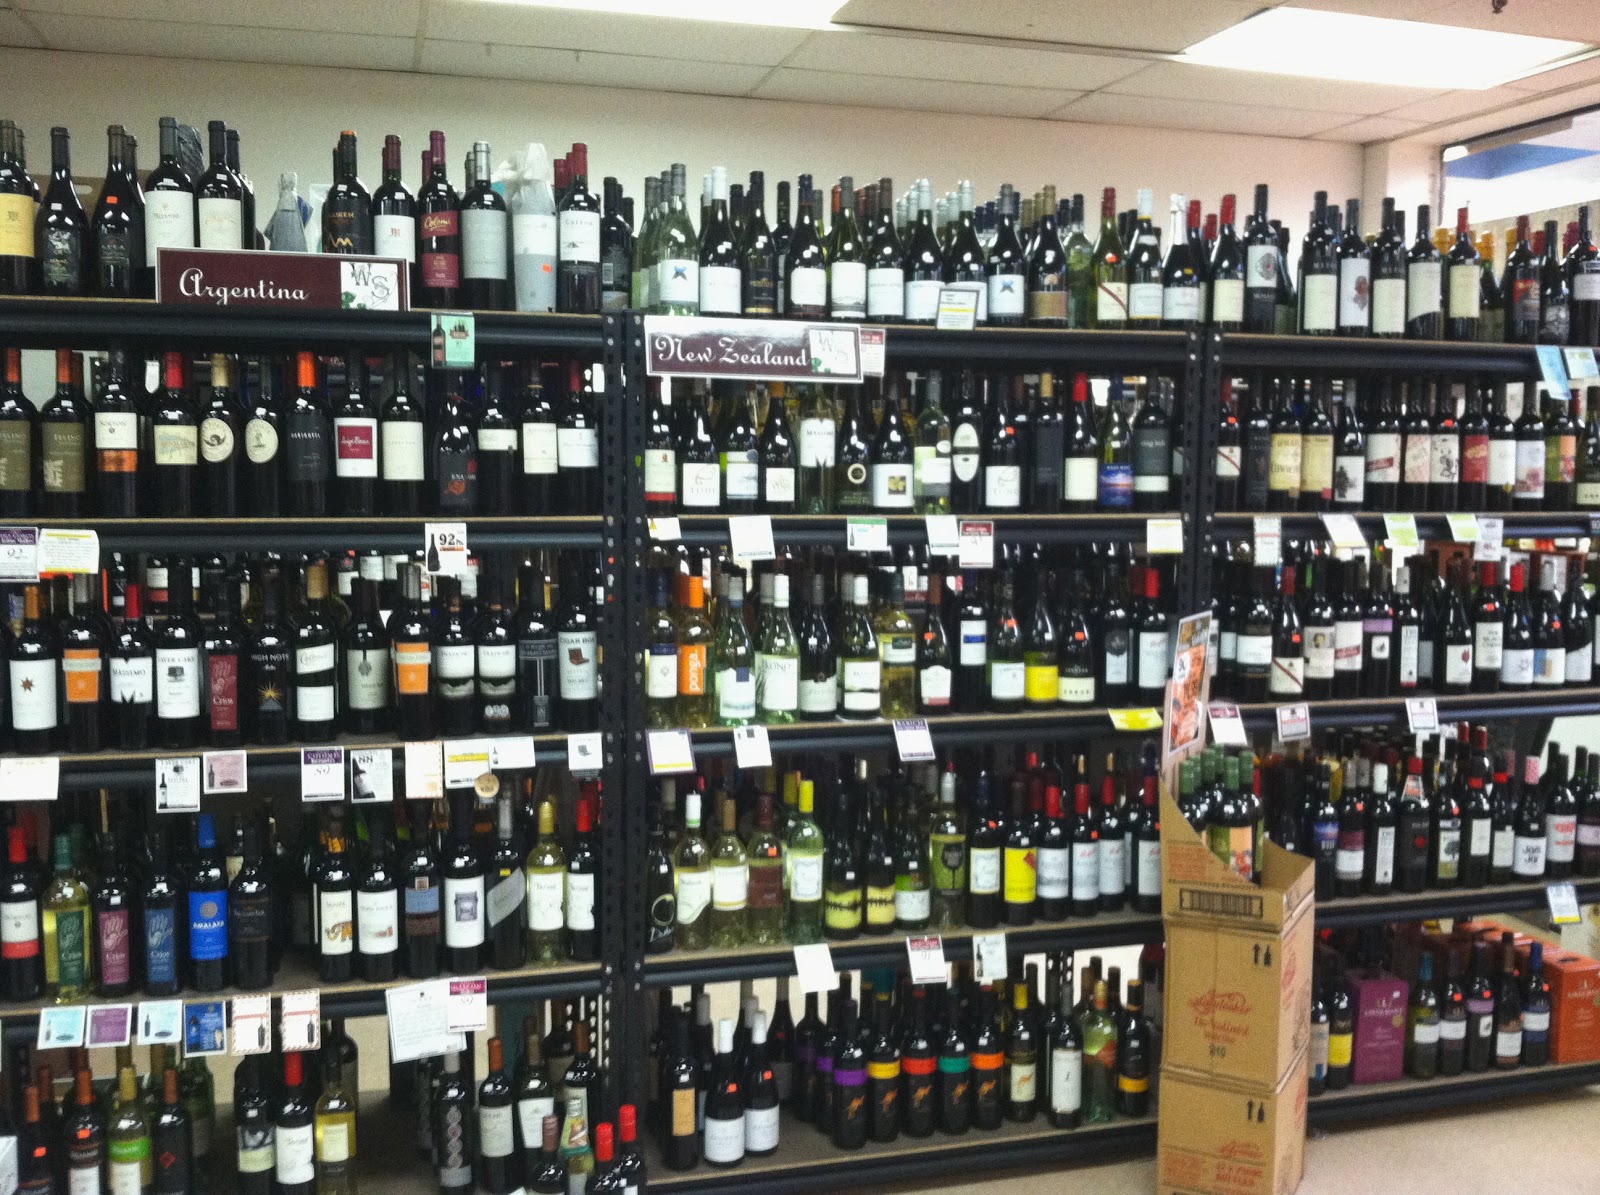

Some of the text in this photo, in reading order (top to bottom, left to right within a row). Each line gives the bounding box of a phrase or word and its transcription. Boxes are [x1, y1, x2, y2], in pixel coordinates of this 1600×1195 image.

[179, 266, 310, 305] Argentina
[655, 335, 810, 367] New Zealand
[439, 532, 456, 546] 92
[251, 653, 290, 661] HIGH NOTE
[688, 652, 703, 692] ponga
[192, 919, 226, 930] AMALAYA
